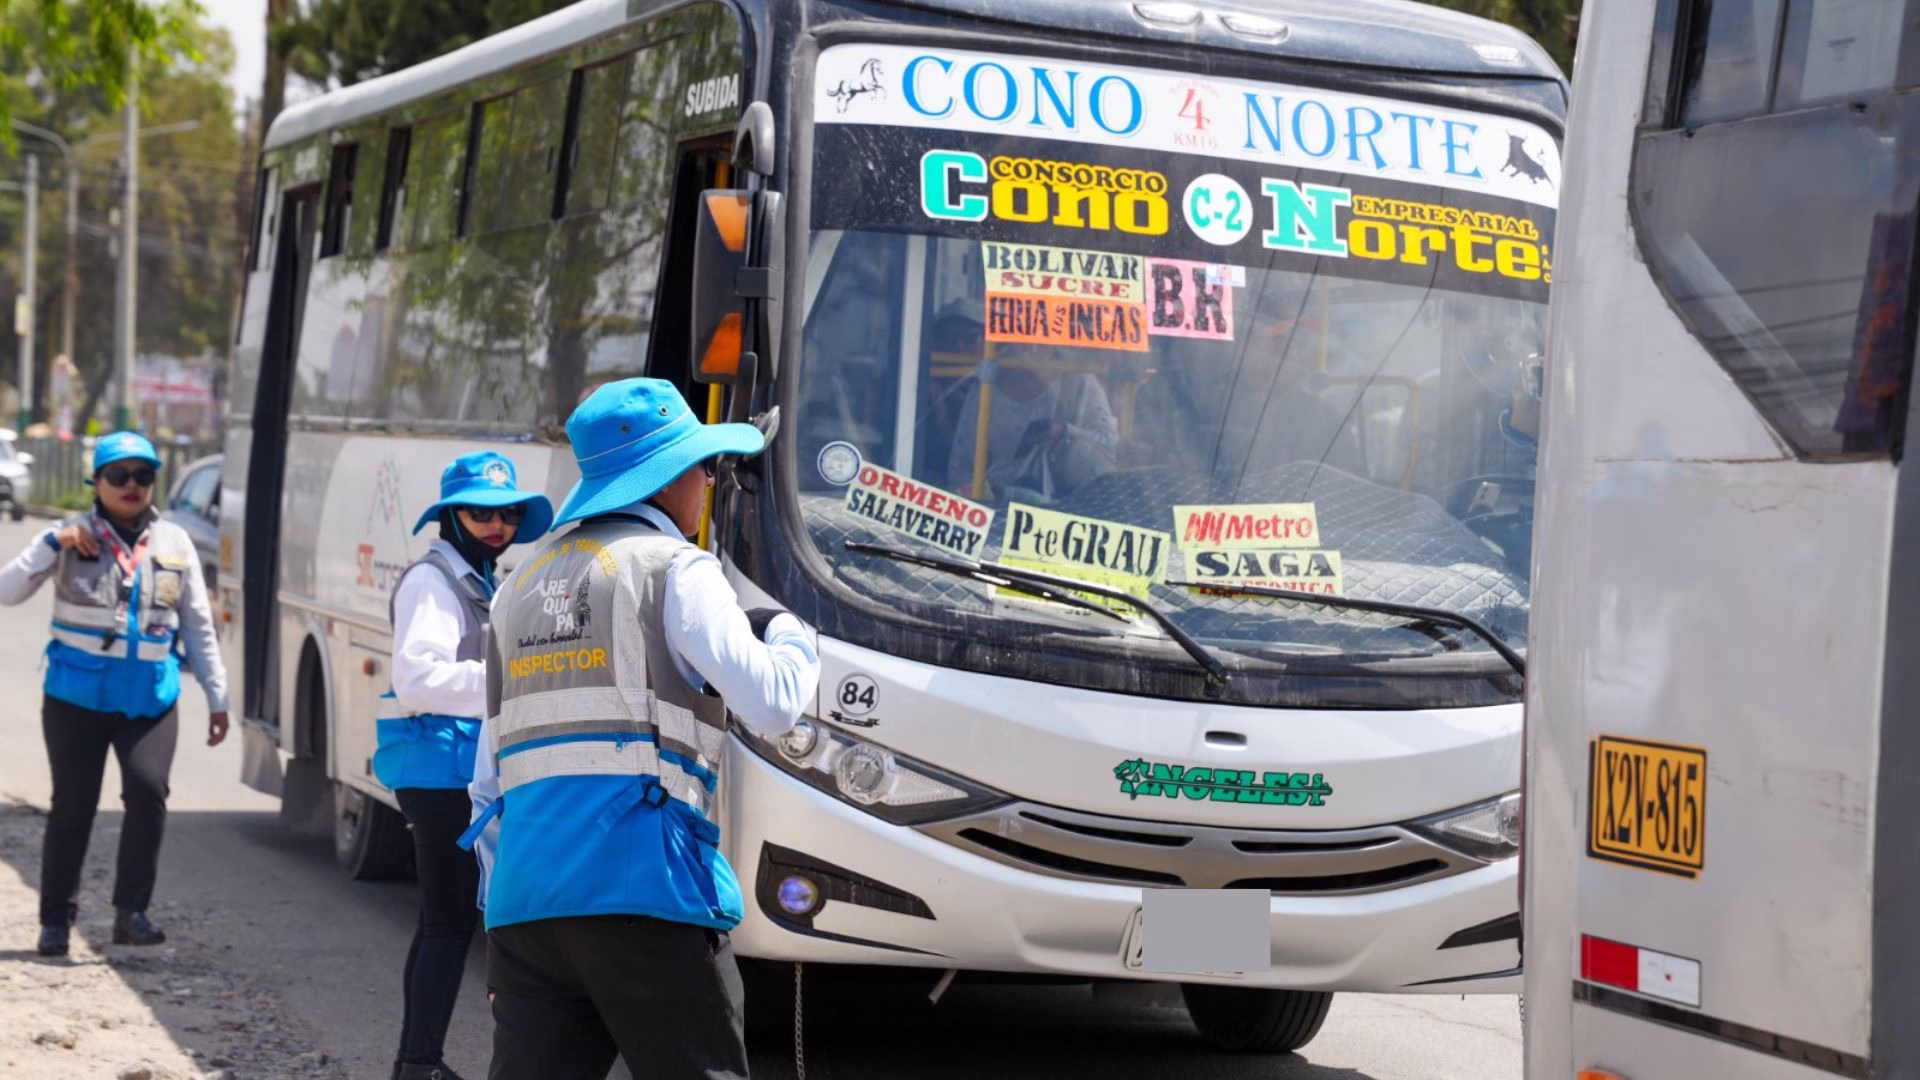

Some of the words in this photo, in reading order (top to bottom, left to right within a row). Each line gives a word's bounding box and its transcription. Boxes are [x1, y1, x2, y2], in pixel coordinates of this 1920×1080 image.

[685, 73, 739, 117] SUBIDA
[901, 55, 1144, 135] CONO
[1177, 87, 1211, 131] 4
[1242, 92, 1485, 179] NORTE
[921, 149, 1169, 236] Cono
[990, 156, 1168, 197] CONSORCIO
[1190, 185, 1244, 231] C-2
[1353, 196, 1540, 240] EMPRESARIAL
[984, 245, 1139, 282] BOLIVAR
[1001, 271, 1131, 300] SUCRE
[989, 296, 1049, 337] FERIA
[1069, 302, 1141, 344] INCAS
[858, 466, 988, 528] ORMENO
[847, 488, 981, 555] SALAVERRY
[1195, 551, 1336, 578] SAGA
[556, 612, 575, 632] PA
[508, 648, 607, 679] INSPECTOR
[842, 681, 875, 709] 84
[1602, 749, 1698, 857] X2V-815
